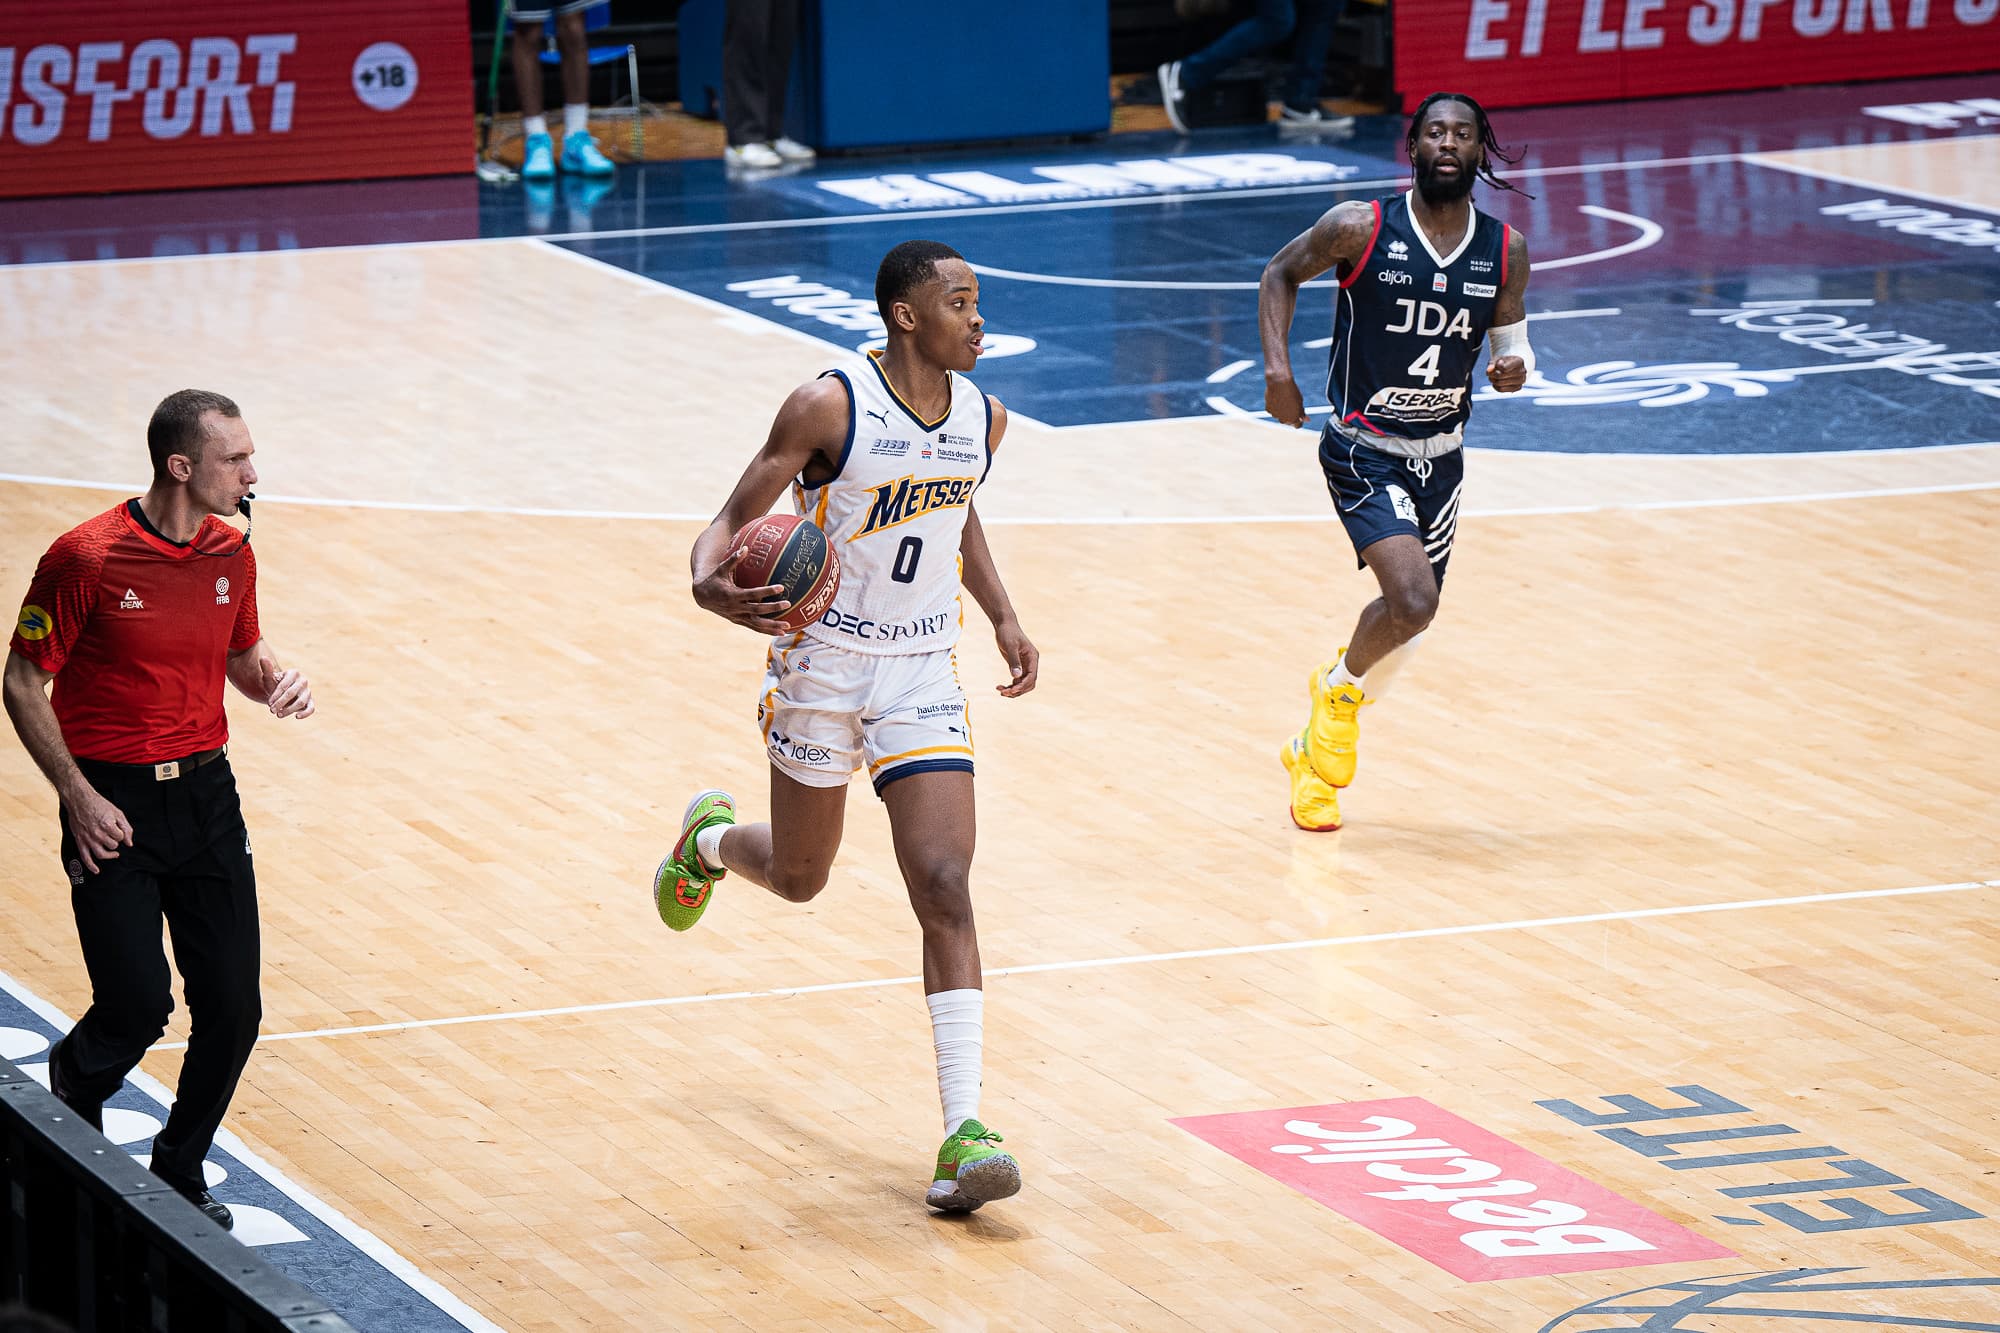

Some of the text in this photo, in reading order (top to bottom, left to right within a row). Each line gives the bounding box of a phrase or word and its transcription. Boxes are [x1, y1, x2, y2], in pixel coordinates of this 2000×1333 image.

[1578, 0, 1668, 53] LE
[0, 33, 297, 146] SFORT
[359, 64, 406, 88] +18
[1378, 269, 1412, 285] dijon
[1385, 298, 1473, 340] JDA
[1407, 344, 1440, 385] 4
[859, 477, 976, 536] METS92
[891, 535, 923, 584] 0
[120, 600, 144, 609] PEAK
[819, 608, 948, 641] DEC SPORT
[791, 741, 831, 761] idex
[1533, 1085, 1987, 1233] ÉLITE
[1269, 1115, 1659, 1258] Betclic
